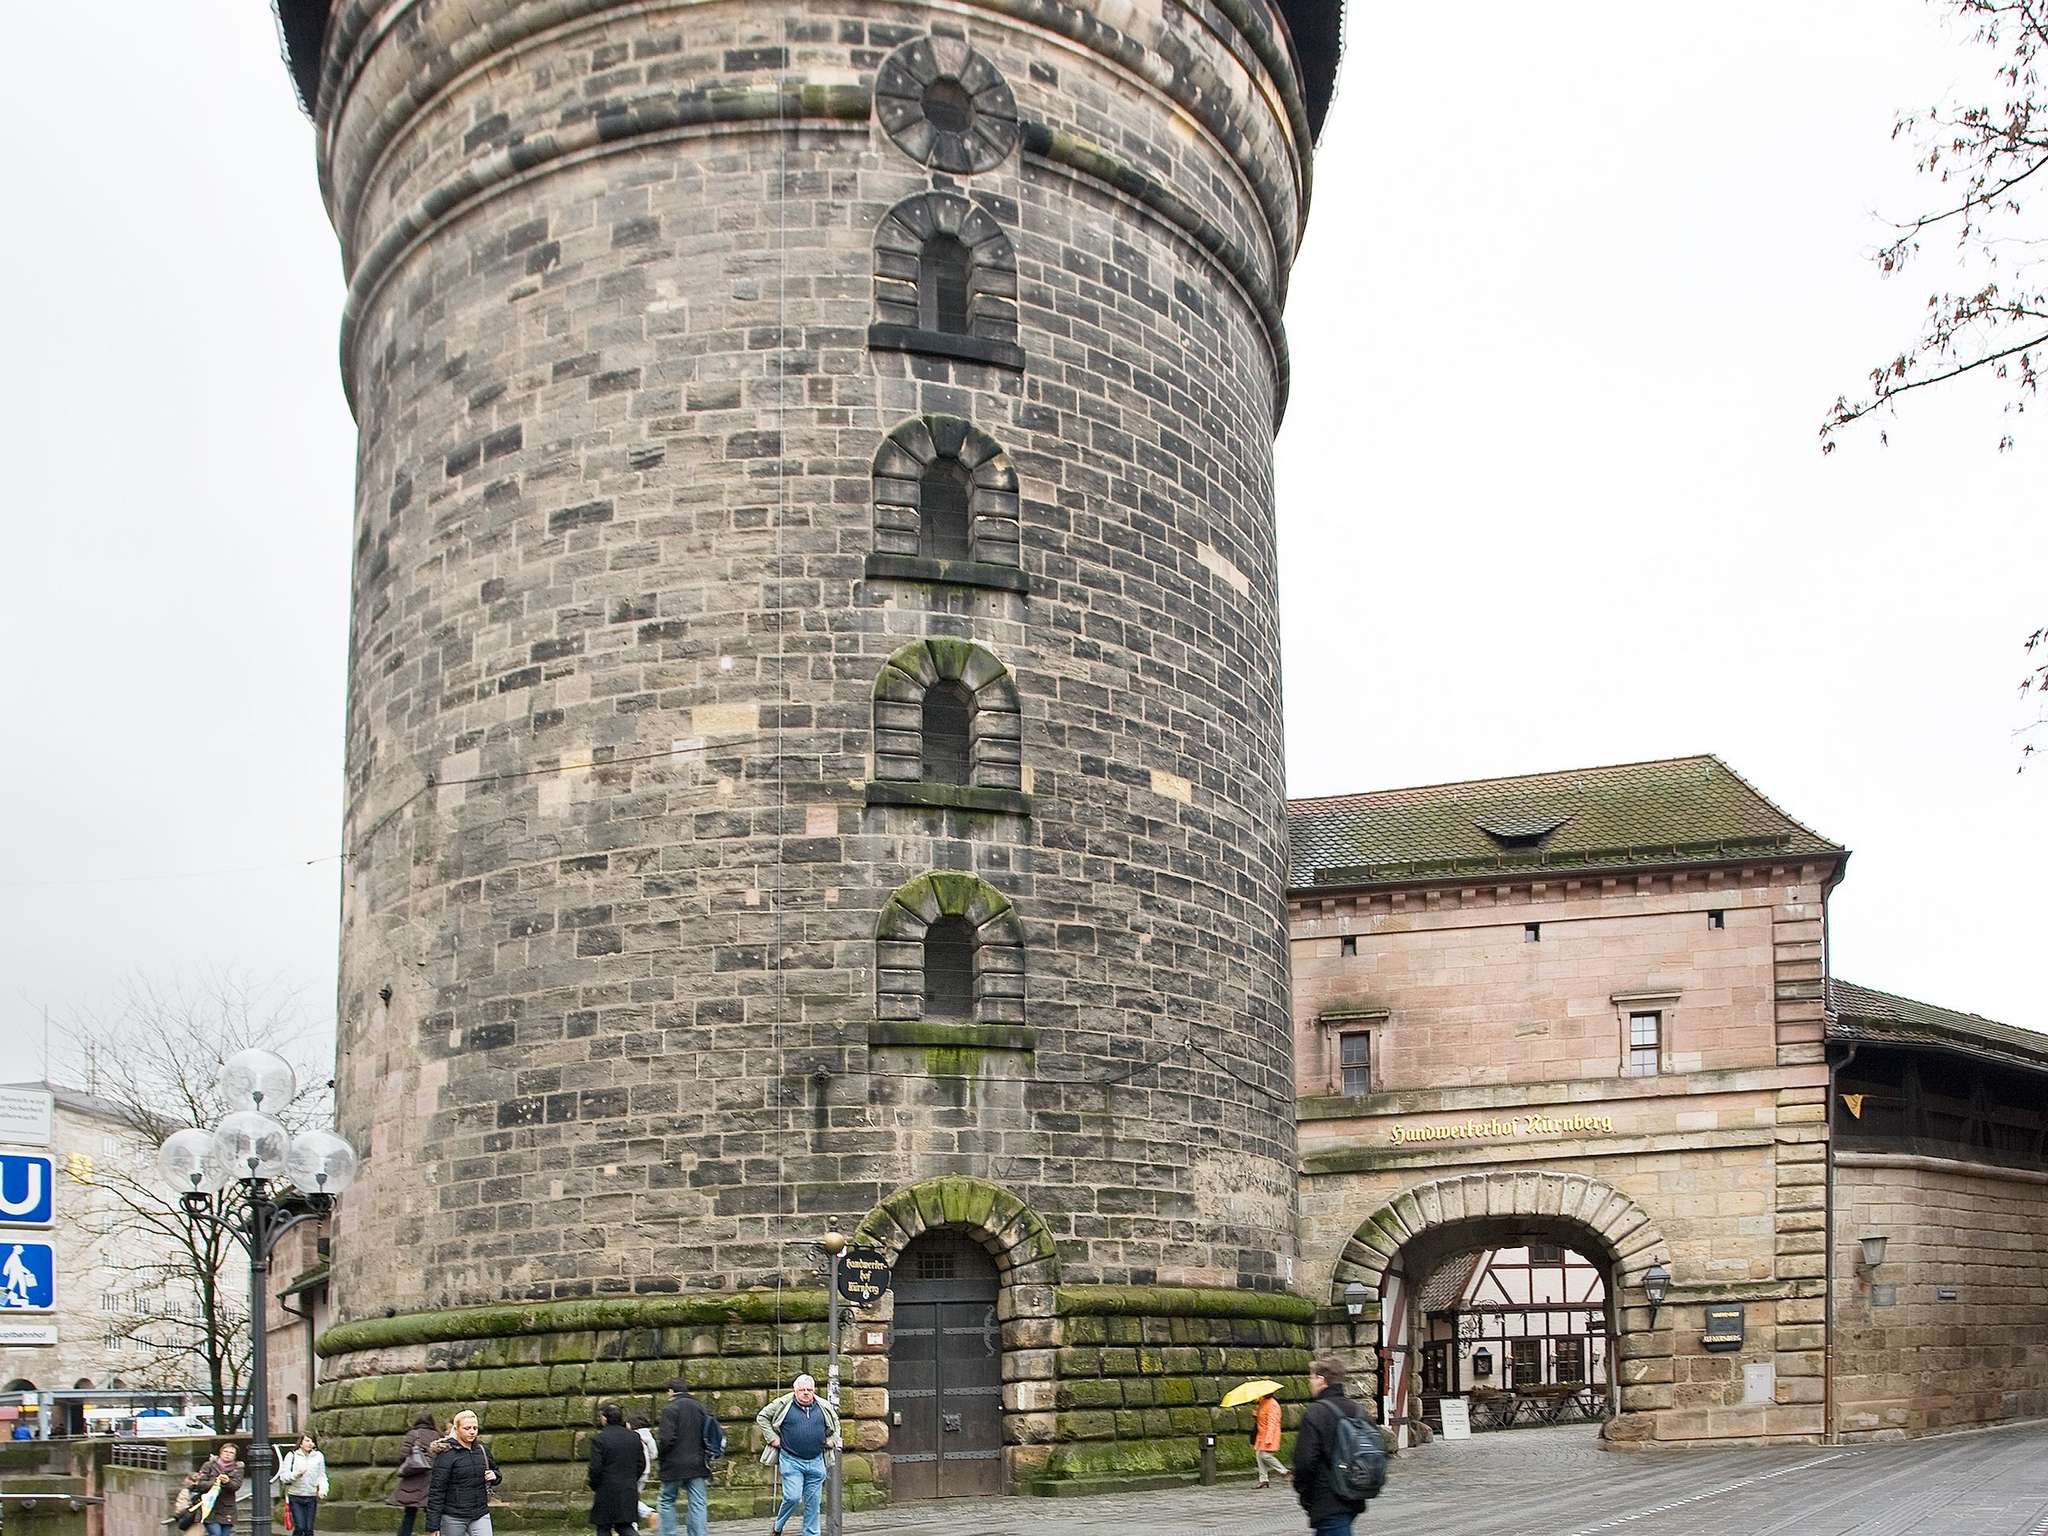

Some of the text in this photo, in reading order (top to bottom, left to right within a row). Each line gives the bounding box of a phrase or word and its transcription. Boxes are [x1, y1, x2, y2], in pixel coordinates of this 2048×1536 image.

[1390, 1113, 1613, 1146] Handwerkerhof Nürnberg
[0, 1161, 41, 1216] U
